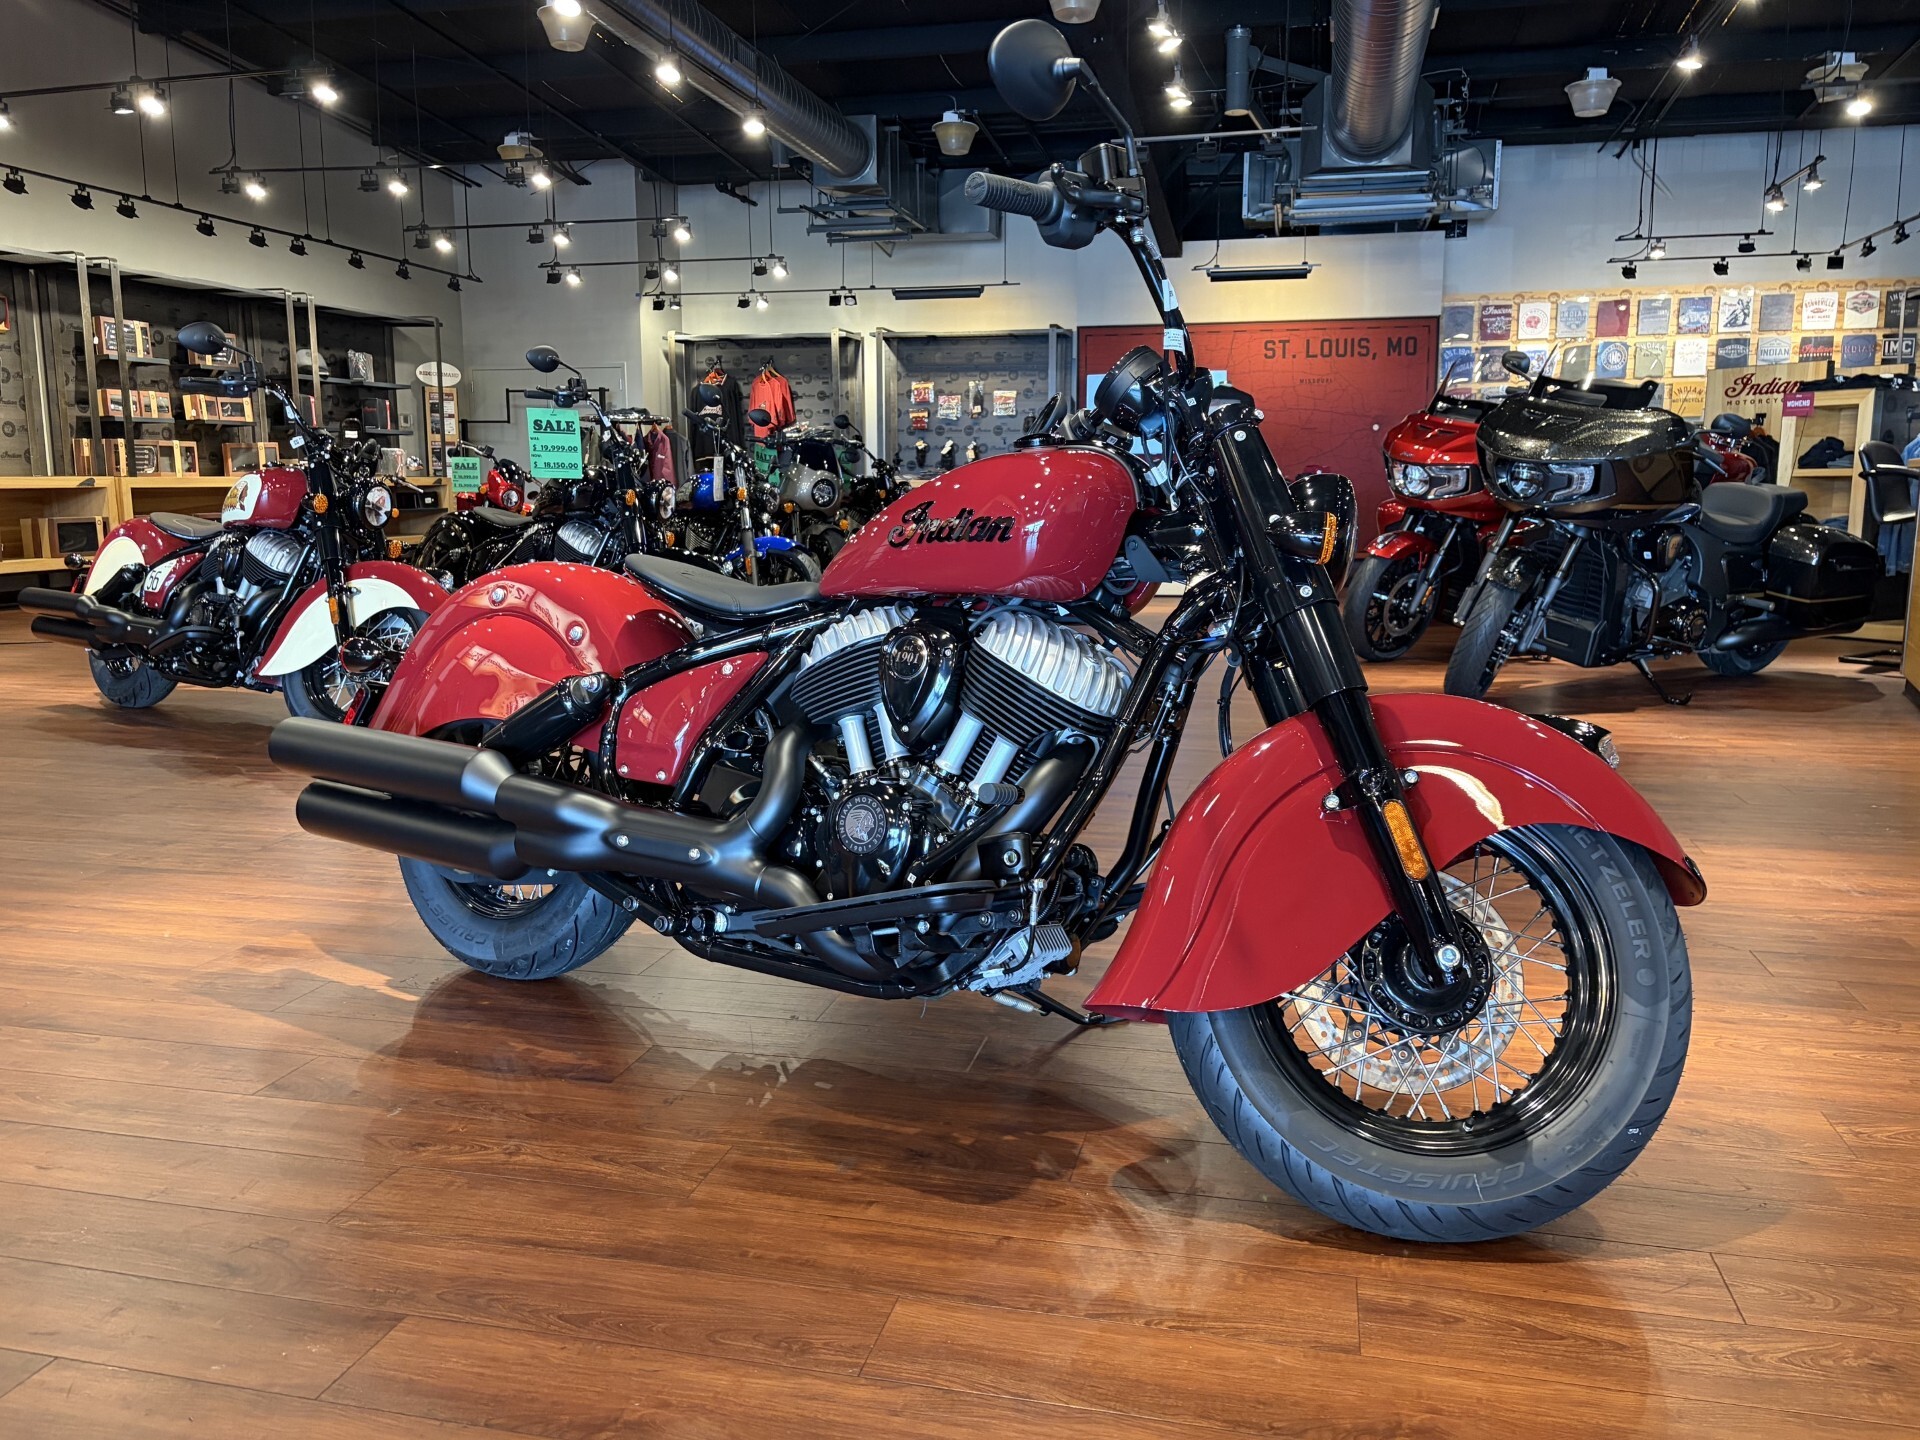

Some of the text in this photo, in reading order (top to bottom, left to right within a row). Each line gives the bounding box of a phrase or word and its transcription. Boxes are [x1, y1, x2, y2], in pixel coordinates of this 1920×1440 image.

[1264, 336, 1418, 361] ST. LOUIS, MO
[1760, 347, 1790, 357] INDIAN
[1884, 340, 1912, 353] IMC
[1299, 377, 1333, 385] MISSOURI
[1724, 372, 1801, 398] Indian
[1673, 385, 1704, 397] INDIAN
[533, 418, 576, 433] SALE
[533, 444, 579, 452] $ 19,999.00
[454, 462, 478, 470] SALE
[533, 461, 579, 470] $ 18,150.00
[887, 501, 1016, 549] Indian
[146, 570, 162, 591] 56
[896, 651, 919, 664] 1901
[840, 796, 884, 845] INDIAN MOTORCYCLE
[1308, 1138, 1526, 1190] CRUISETEC
